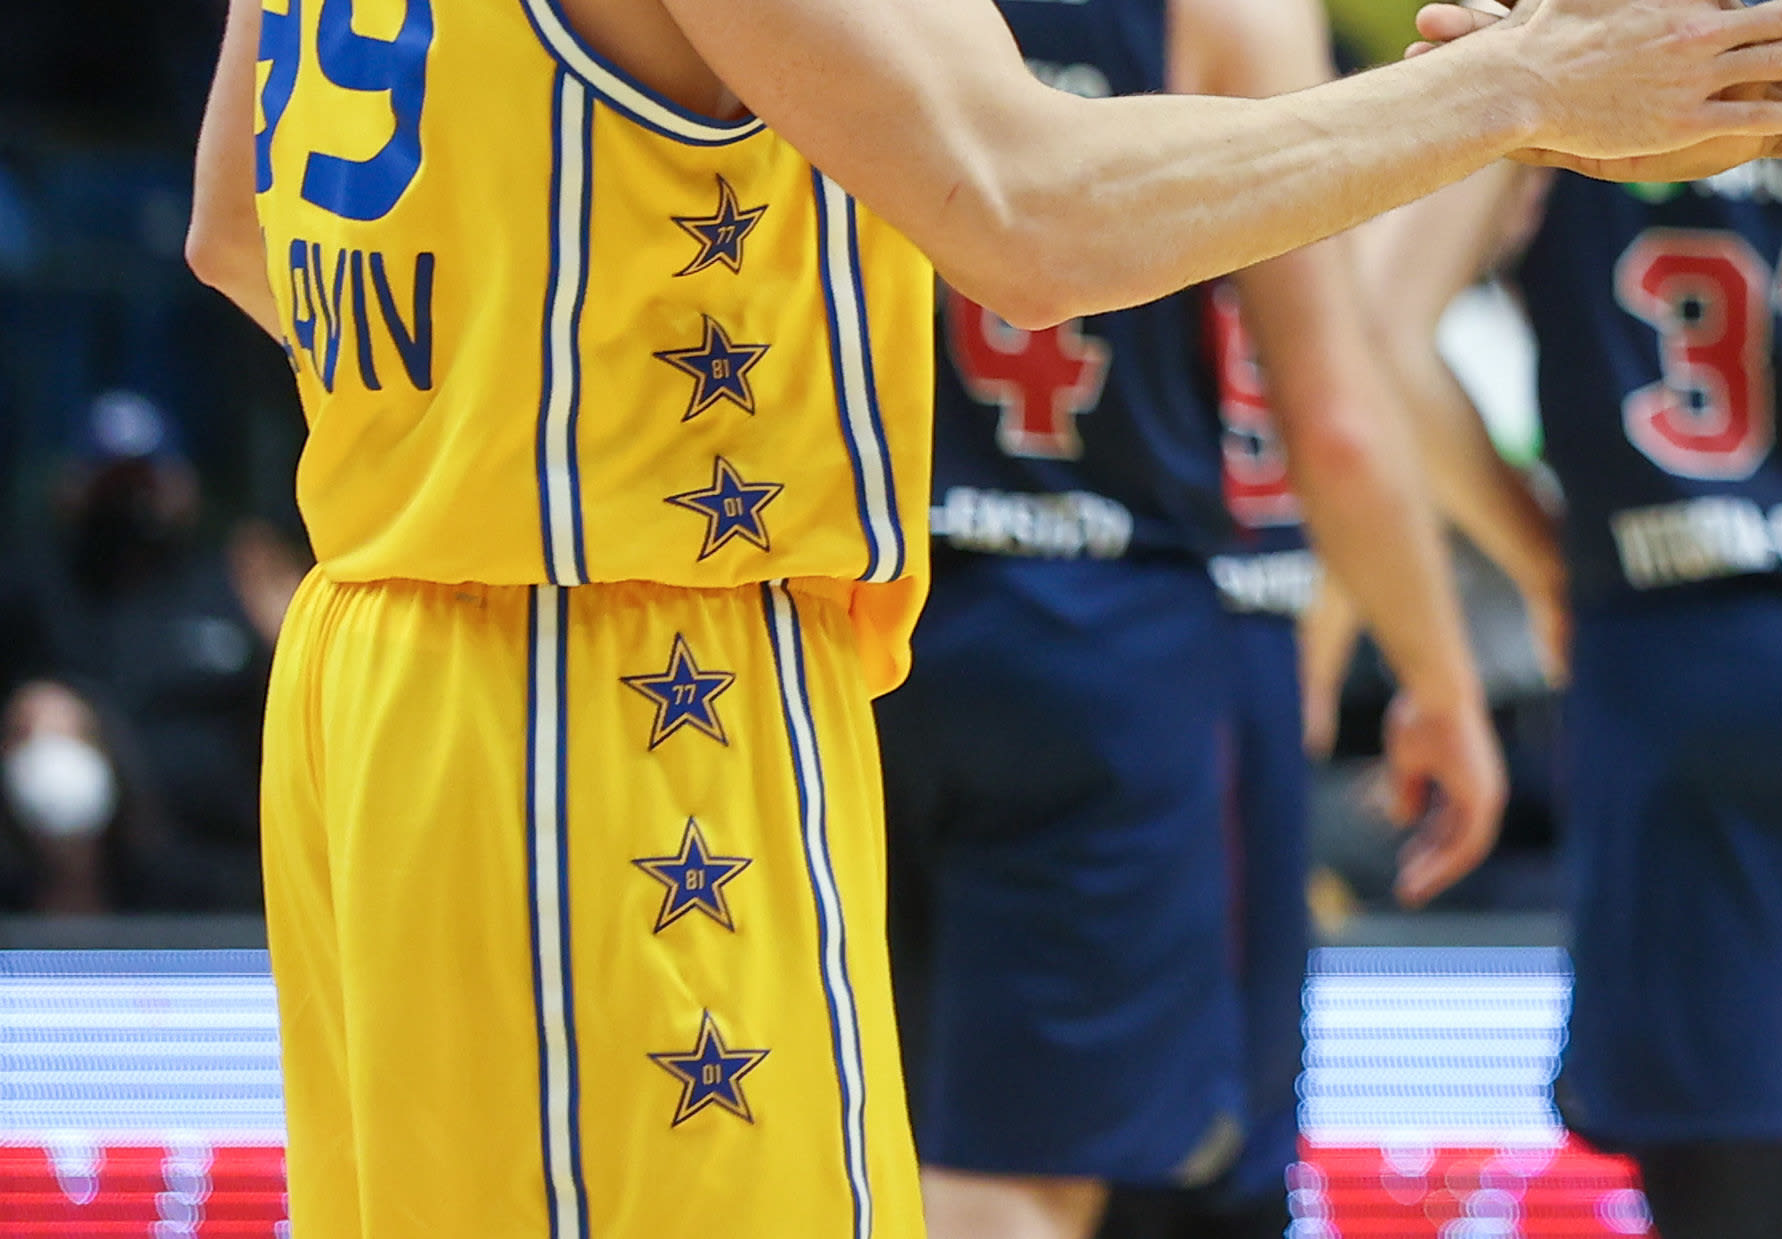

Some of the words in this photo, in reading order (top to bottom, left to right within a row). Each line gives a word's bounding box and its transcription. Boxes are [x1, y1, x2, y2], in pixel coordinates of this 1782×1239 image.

[717, 225, 735, 245] 77
[711, 359, 730, 378] 81
[723, 497, 744, 517] 01
[671, 683, 696, 706] 77
[685, 869, 706, 890] 81
[702, 1063, 722, 1085] 01
